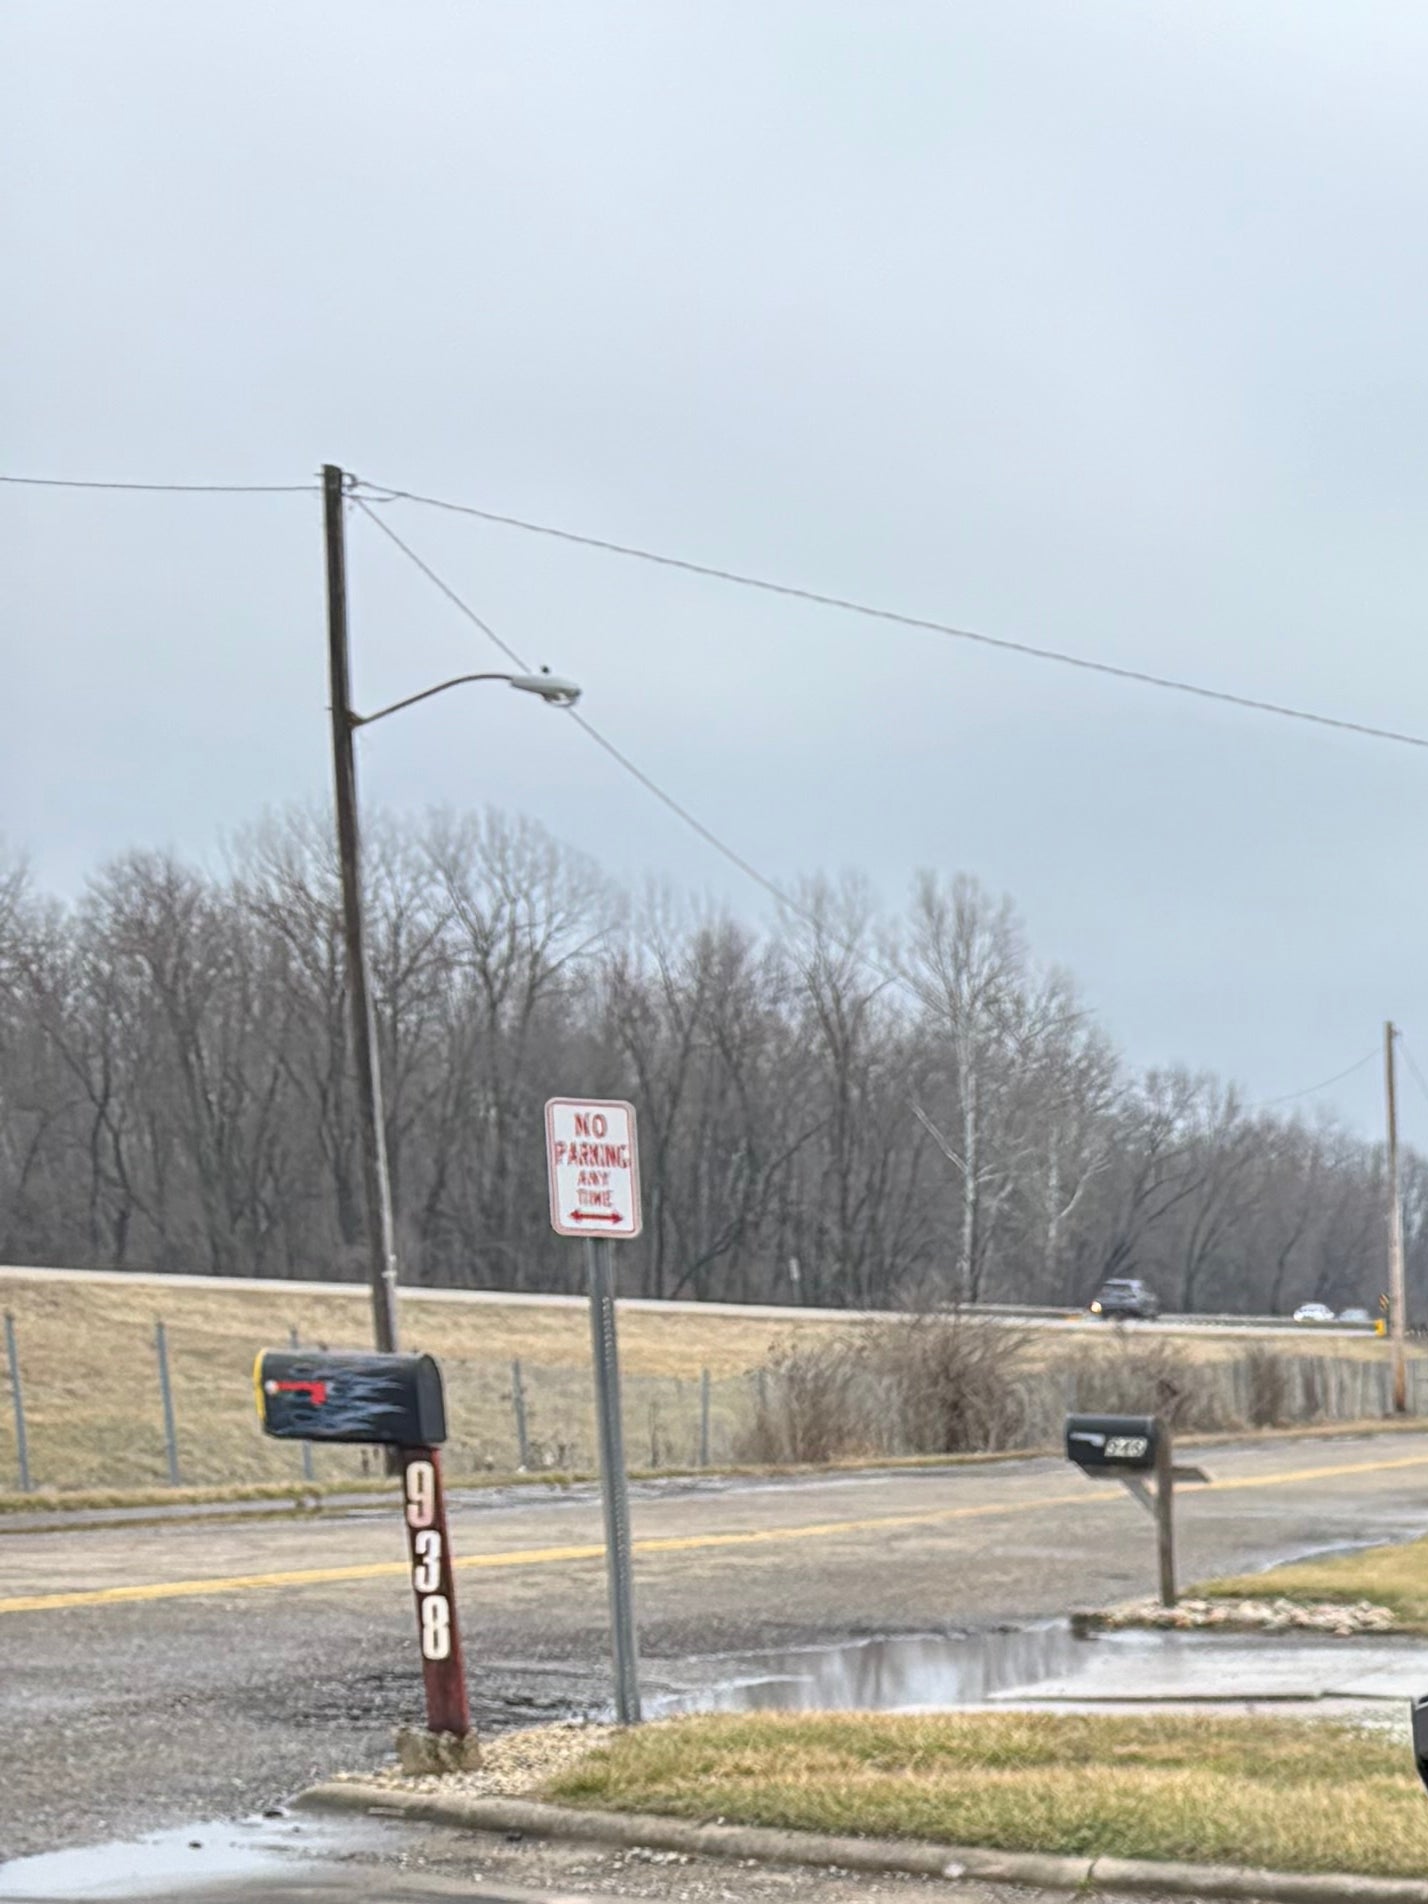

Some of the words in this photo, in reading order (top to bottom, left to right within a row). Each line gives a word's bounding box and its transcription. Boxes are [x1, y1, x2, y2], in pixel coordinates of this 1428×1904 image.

[574, 1113, 608, 1137] NO
[555, 1141, 630, 1169] PARKING
[577, 1170, 611, 1187] ANY
[577, 1188, 613, 1207] TIME
[405, 1461, 450, 1660] 938
